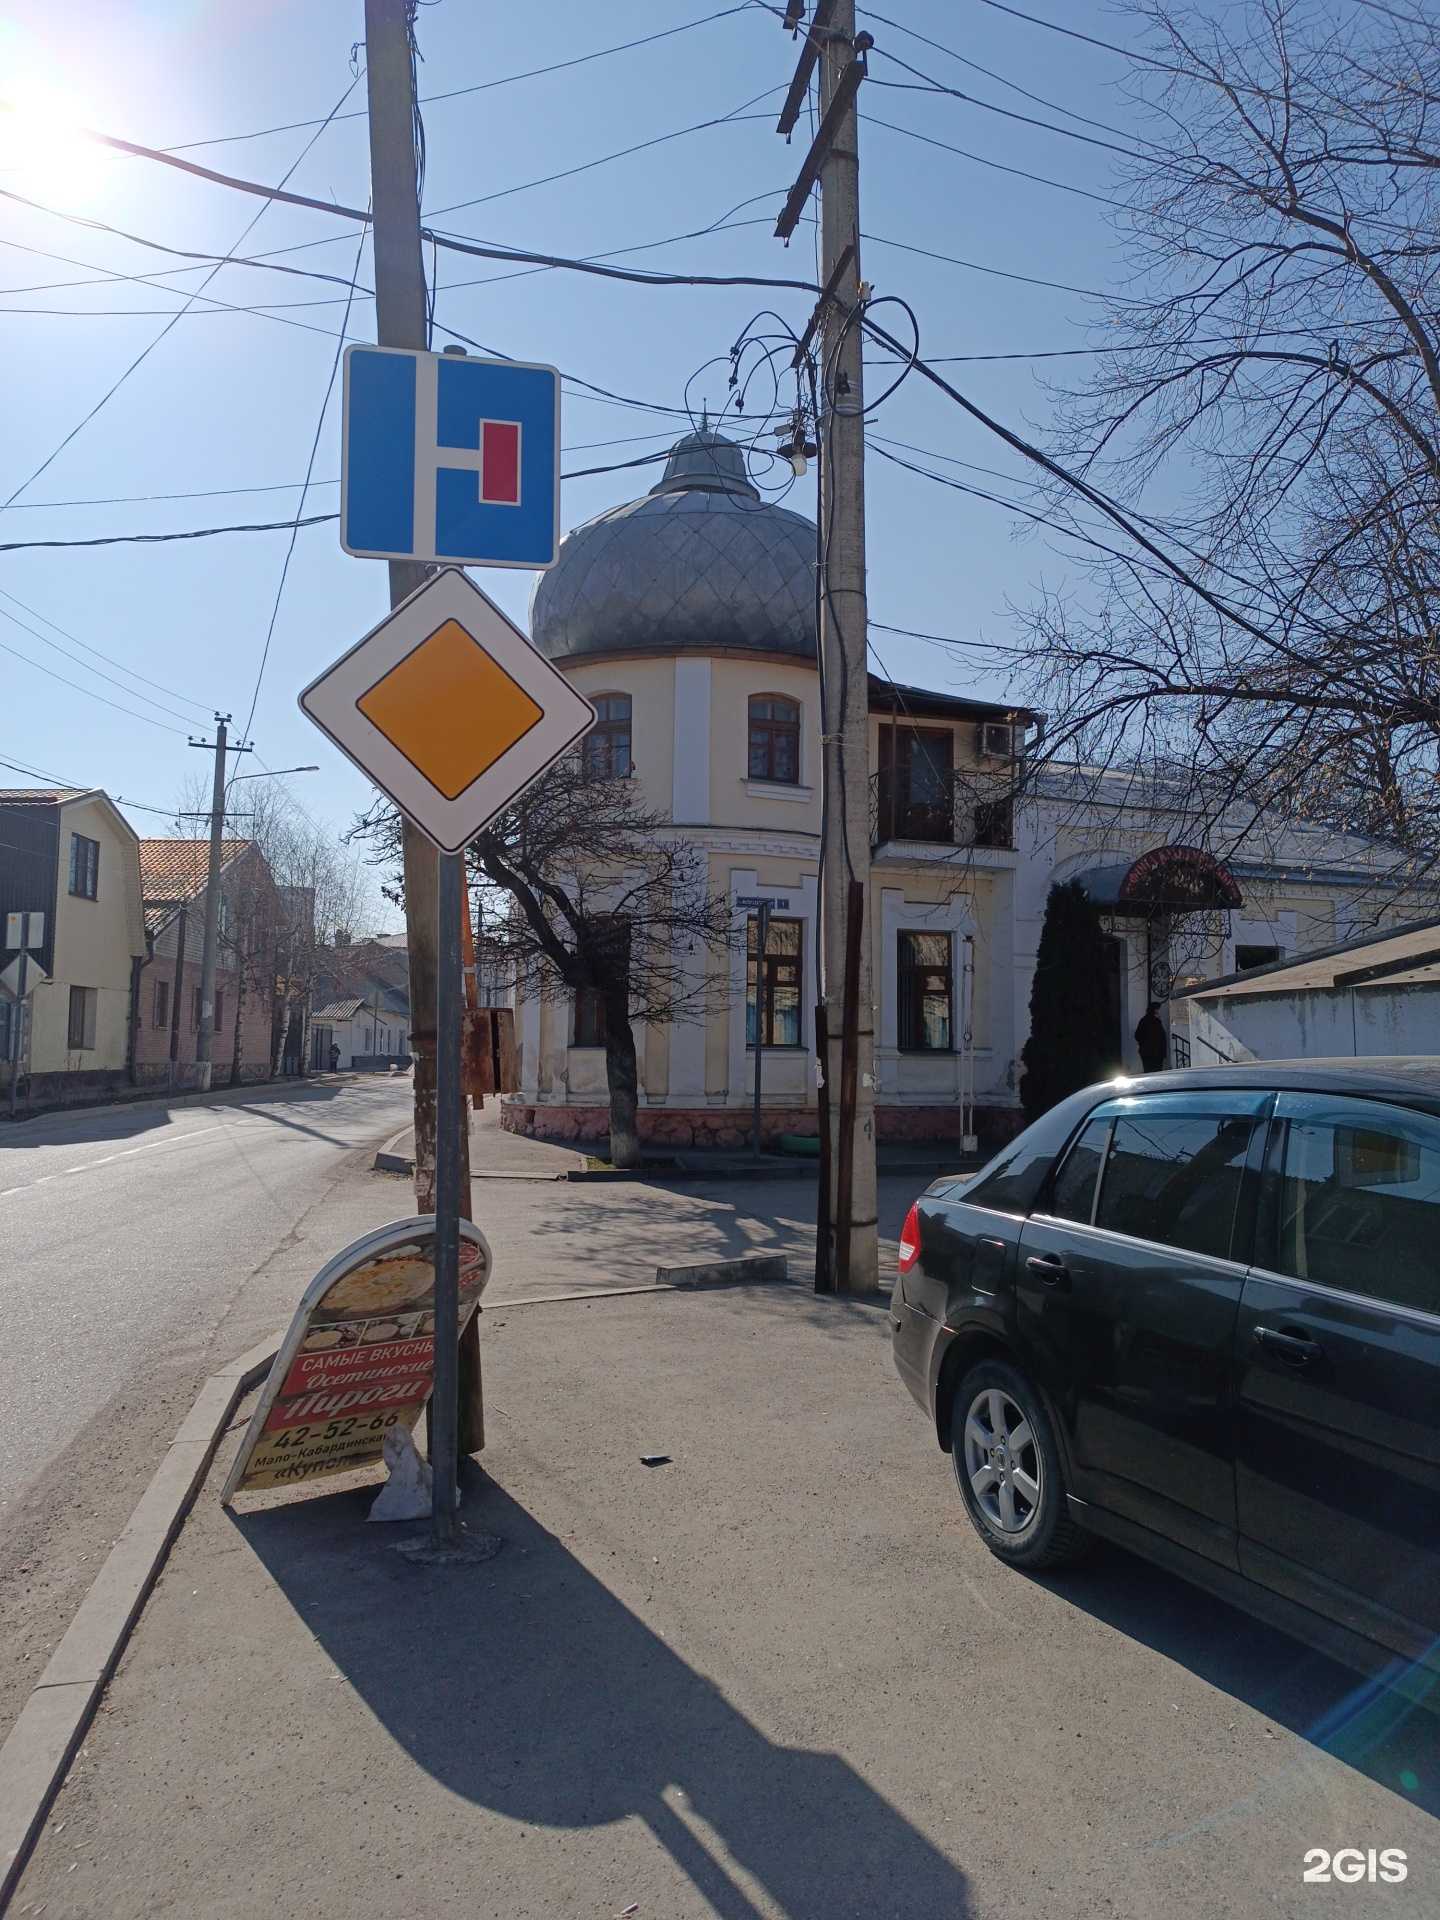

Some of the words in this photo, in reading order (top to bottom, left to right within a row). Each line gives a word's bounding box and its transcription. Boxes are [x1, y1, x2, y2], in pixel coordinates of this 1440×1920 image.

[302, 1350, 367, 1371] САМЫЕ
[370, 1341, 433, 1360] ВКУСНЫ
[306, 1359, 434, 1389] Осетинские
[283, 1380, 424, 1420] Пироги
[273, 1411, 398, 1449] 42-52-66
